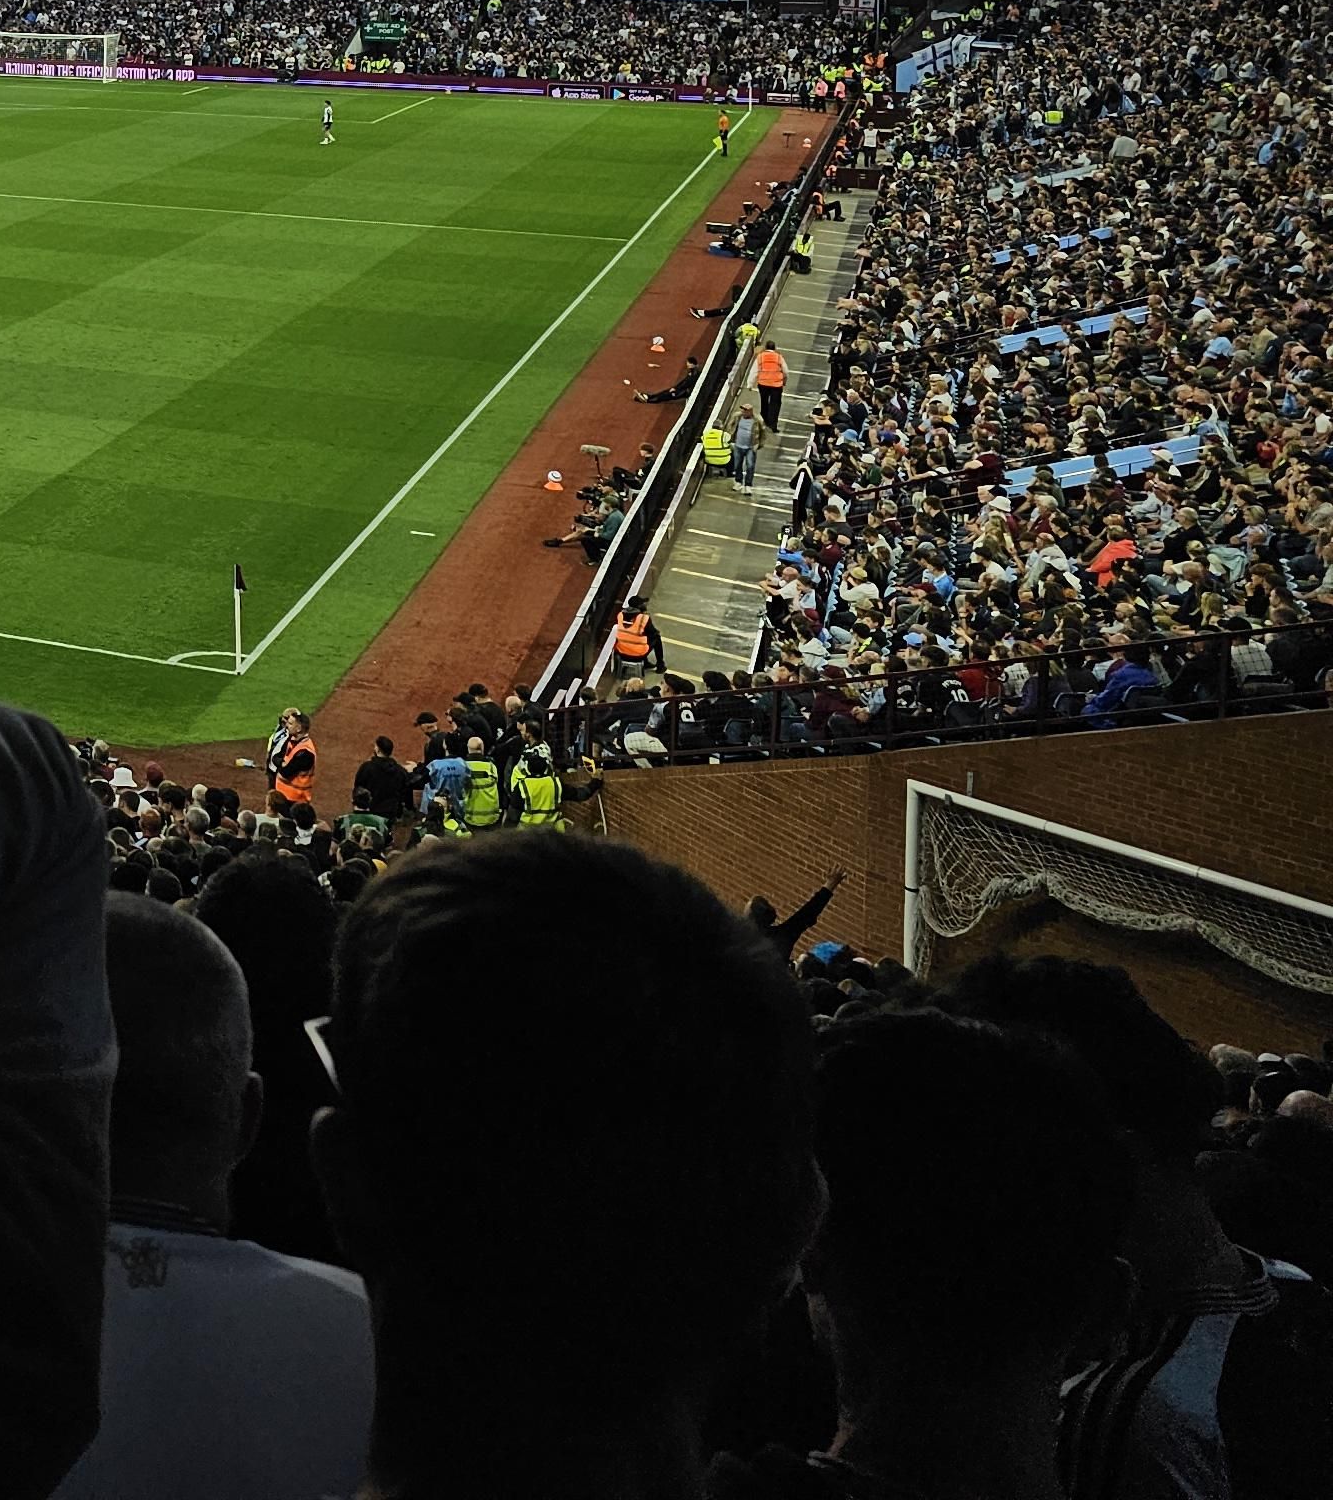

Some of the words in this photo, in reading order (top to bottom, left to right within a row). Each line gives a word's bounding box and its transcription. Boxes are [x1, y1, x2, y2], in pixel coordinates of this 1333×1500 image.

[175, 69, 195, 82] APP
[563, 92, 579, 100] App
[580, 92, 600, 100] Store
[629, 94, 655, 102] Google
[951, 689, 970, 703] 10
